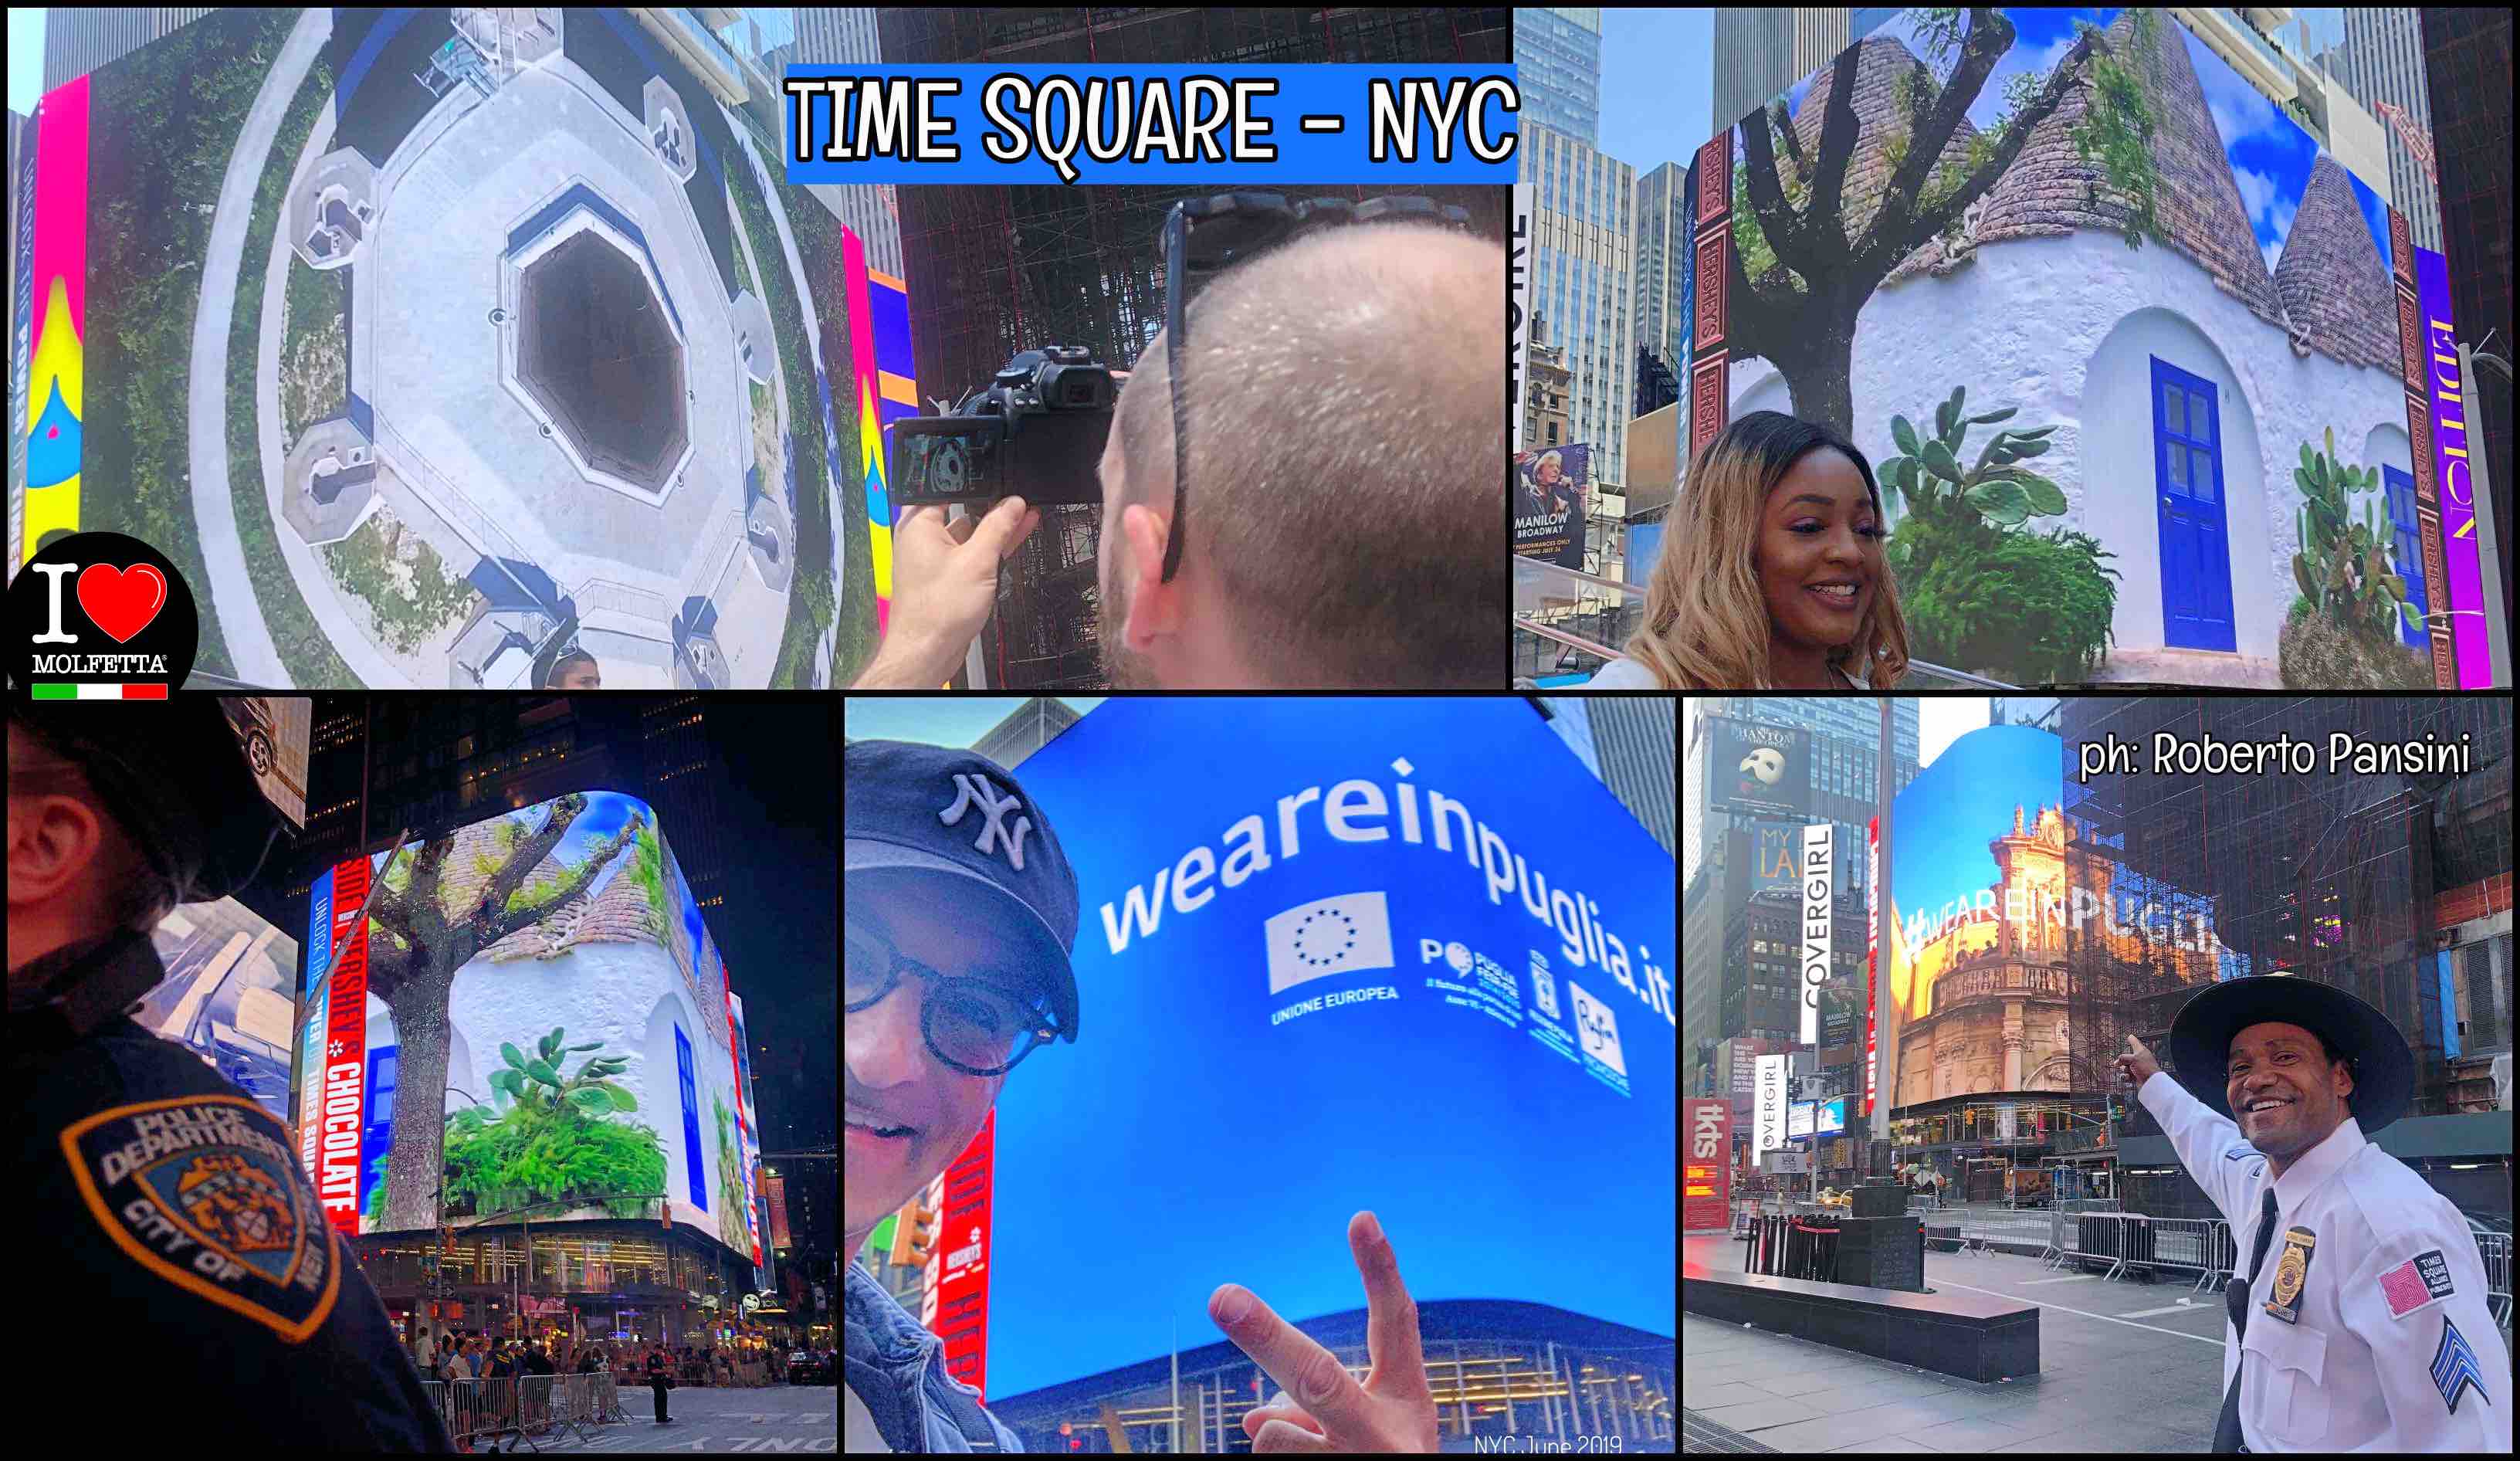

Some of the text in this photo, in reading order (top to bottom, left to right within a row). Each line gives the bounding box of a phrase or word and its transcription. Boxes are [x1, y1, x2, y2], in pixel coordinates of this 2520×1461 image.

[13, 322, 28, 436] POWER
[1514, 513, 1569, 530] MANILOW
[1517, 525, 1563, 538] BROADWAY
[1761, 828, 1793, 847] MY
[1099, 756, 1675, 1027] weareinpuglia.it
[1805, 829, 1829, 1009] COVERGIRL
[313, 897, 328, 953] UNLOCK
[1271, 985, 1400, 1026] UNIONE EUROPEA
[134, 1107, 246, 1137] POLICE
[305, 1068, 320, 1122] TIMES
[101, 1121, 294, 1185] DEPARTMENT
[321, 1062, 361, 1212] CHOCOLATE
[1693, 1103, 1725, 1158] tkts
[124, 1199, 194, 1253] CITY
[194, 1250, 246, 1281] OF
